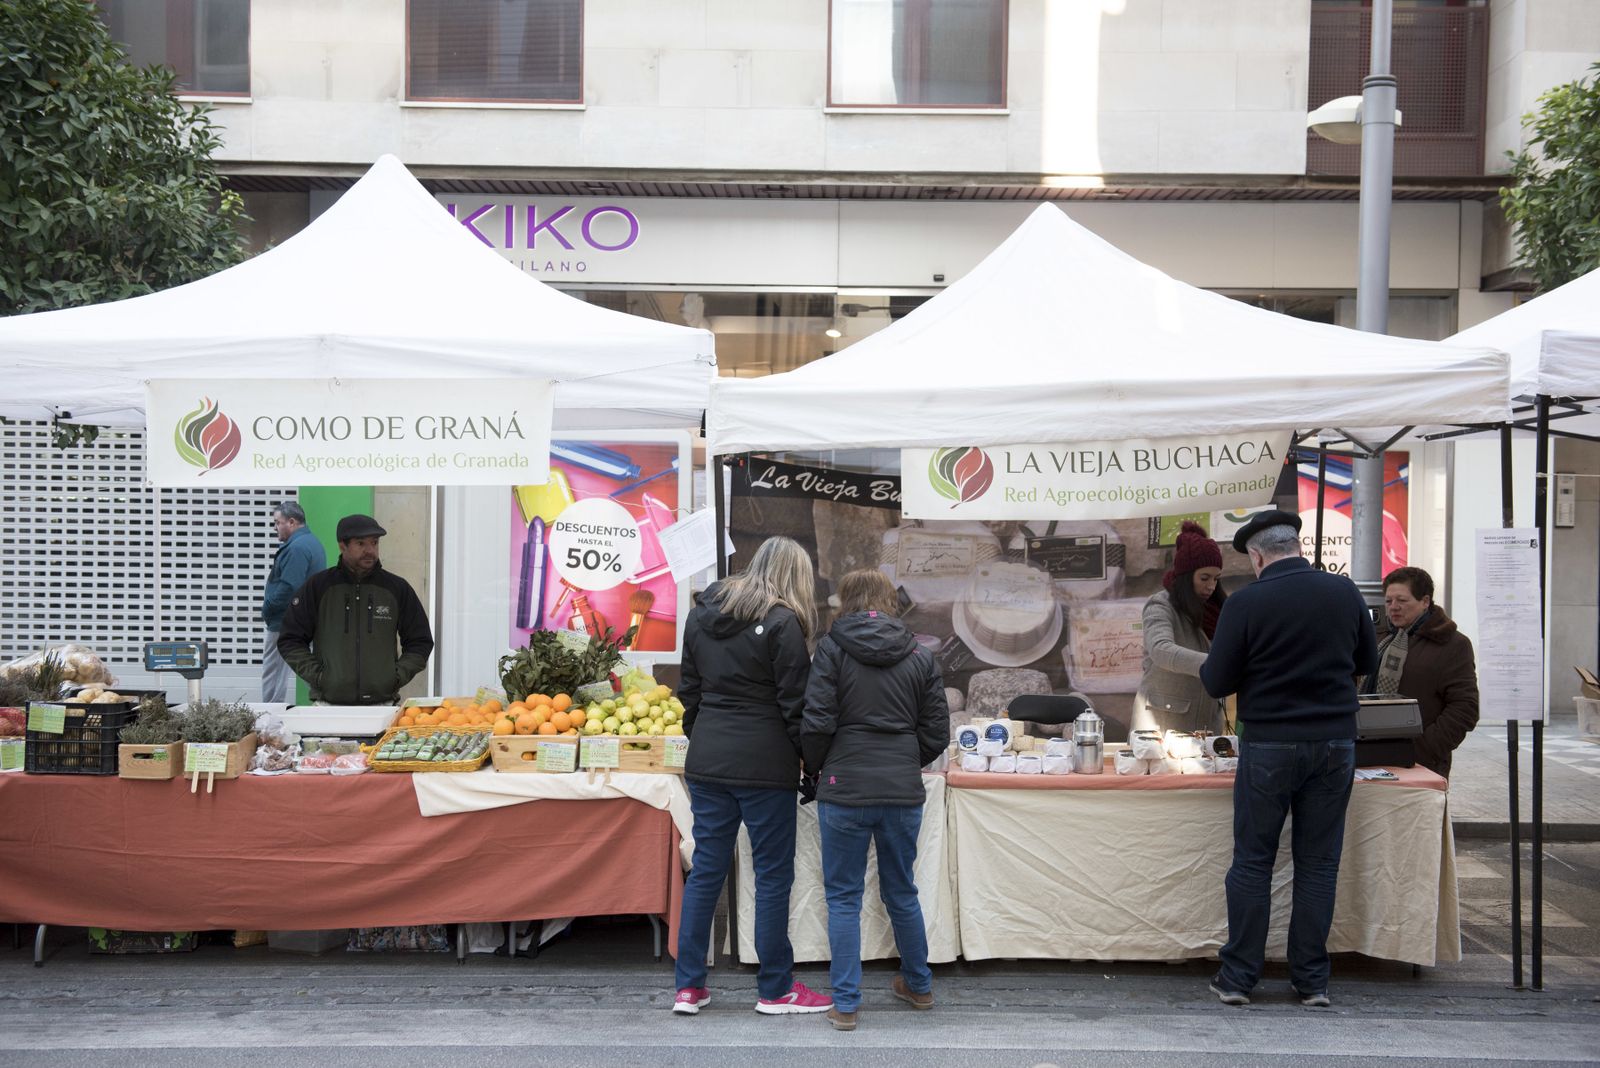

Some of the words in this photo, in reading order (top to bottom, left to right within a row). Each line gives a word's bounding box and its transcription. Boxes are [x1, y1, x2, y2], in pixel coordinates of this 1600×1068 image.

[447, 203, 640, 251] KIKO
[511, 260, 587, 272] ILANO
[252, 415, 351, 441] COMO
[363, 416, 404, 440] DE
[415, 410, 525, 440] GRANÁ
[253, 452, 287, 469] Red
[294, 452, 420, 473] Agroecológica
[427, 452, 447, 469] de
[453, 452, 529, 469] Granada
[1005, 450, 1042, 474] LA
[1048, 449, 1127, 477] VIEJA
[1133, 440, 1277, 472] BUCHACA
[751, 465, 792, 489] La
[795, 471, 860, 501] Vieja
[1004, 486, 1037, 503] Red
[1045, 483, 1173, 507] Agroecológica
[1178, 481, 1199, 498] de
[1203, 475, 1276, 496] Granada
[556, 521, 637, 539] DESCUENTOS
[577, 538, 603, 546] HASTA
[1300, 536, 1352, 546] CUENTO
[565, 547, 622, 573] 50%
